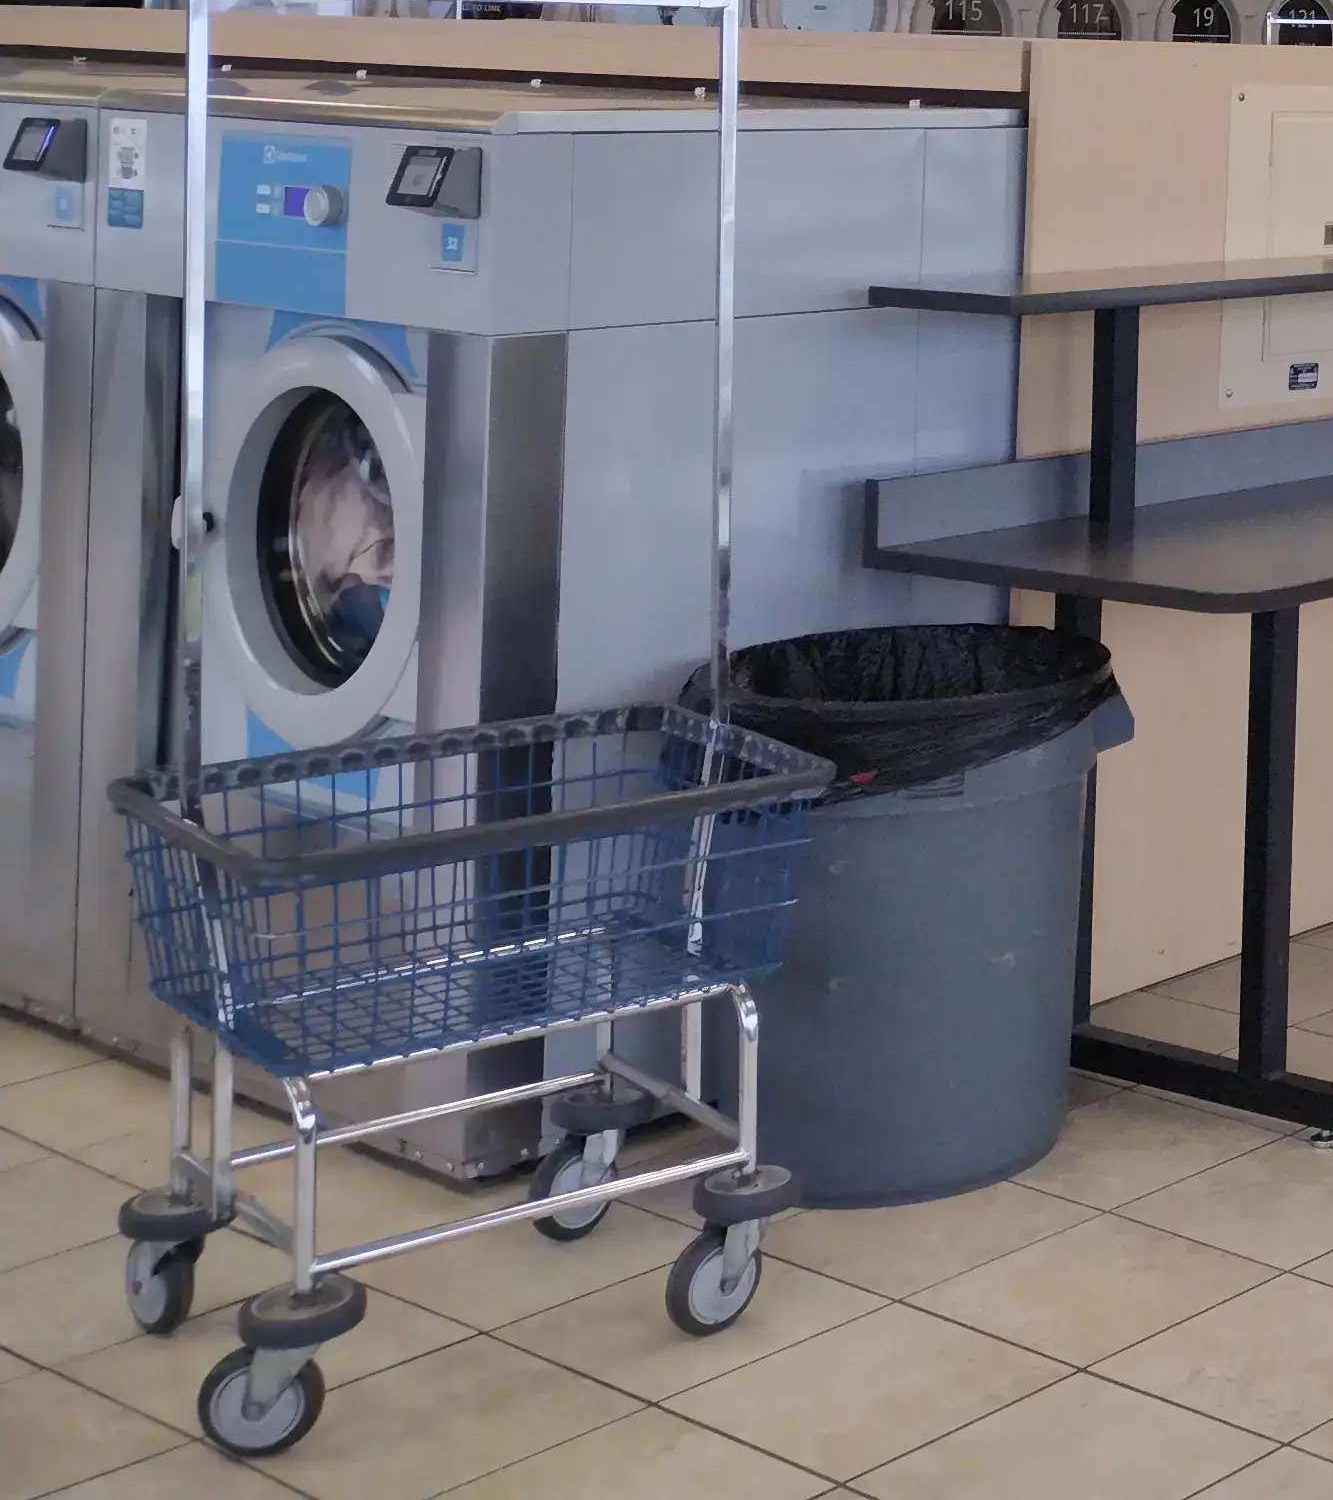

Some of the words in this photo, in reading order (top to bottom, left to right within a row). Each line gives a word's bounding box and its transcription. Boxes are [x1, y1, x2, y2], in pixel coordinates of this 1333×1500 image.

[945, 0, 983, 21] 115
[1069, 3, 1106, 24] 117
[1288, 8, 1316, 29] 121
